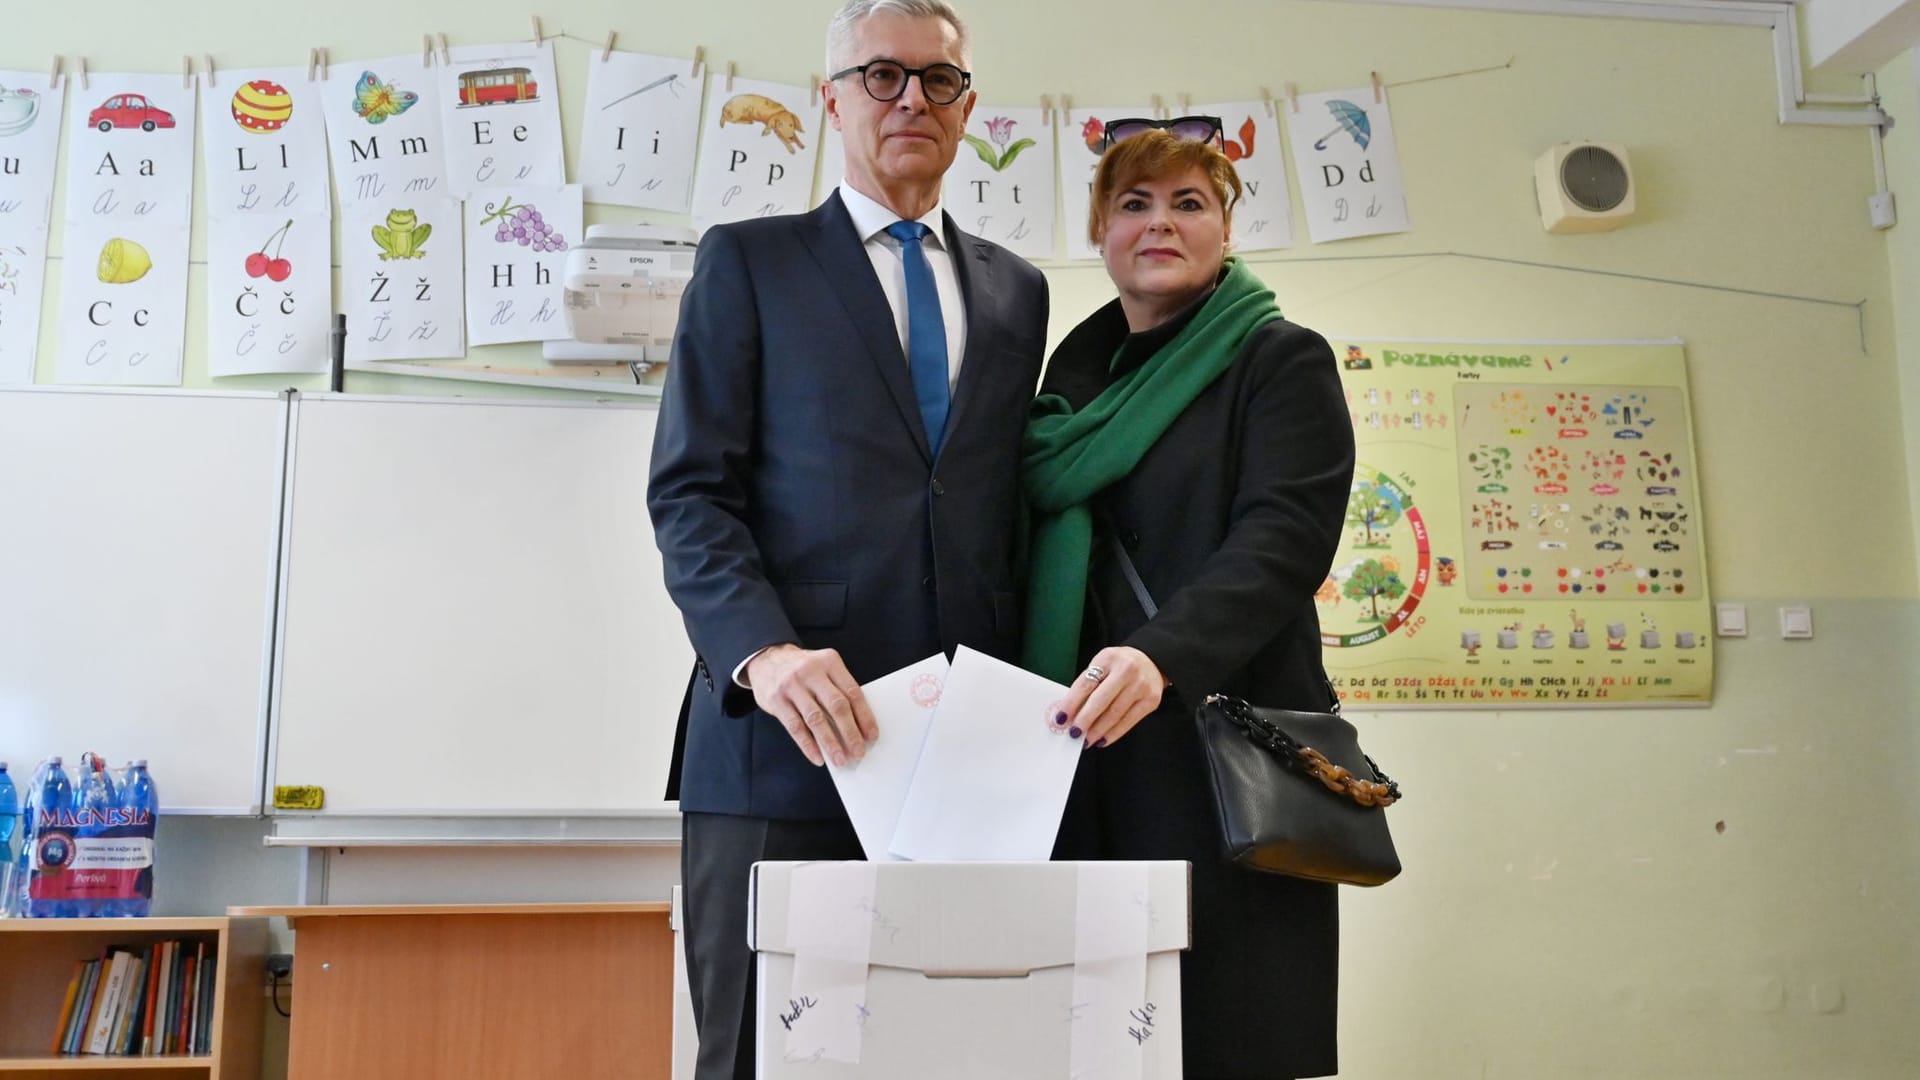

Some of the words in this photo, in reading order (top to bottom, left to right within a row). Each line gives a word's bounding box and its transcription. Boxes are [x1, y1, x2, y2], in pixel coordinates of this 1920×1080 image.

[472, 121, 493, 145] E
[513, 124, 528, 142] e
[616, 127, 626, 150] I
[651, 130, 660, 154] i
[236, 147, 257, 171] L
[280, 144, 289, 168] l
[350, 136, 381, 163] M
[399, 136, 428, 155] m
[3, 156, 21, 175] u
[94, 151, 120, 176] A
[139, 158, 155, 176] a
[476, 157, 496, 182] E
[514, 164, 533, 180] e
[728, 150, 748, 172] P
[767, 163, 784, 185] p
[1322, 164, 1344, 187] D
[1358, 160, 1375, 183] d
[237, 184, 260, 209] L
[275, 181, 298, 207] l
[355, 172, 385, 199] M
[403, 177, 437, 192] m
[722, 185, 742, 207] P
[971, 180, 990, 203] T
[1012, 184, 1022, 204] t
[1245, 182, 1259, 197] v
[92, 189, 120, 214] A
[133, 201, 157, 215] a
[1366, 195, 1383, 219] d
[370, 270, 391, 303] Ž
[415, 277, 432, 301] ž
[491, 263, 514, 288] H
[535, 261, 551, 285] h
[88, 300, 112, 327] C
[133, 308, 150, 327] c
[235, 286, 258, 317] Č
[279, 291, 295, 315] č
[530, 297, 556, 323] h
[85, 340, 107, 366] C
[129, 351, 150, 366] c
[1382, 349, 1532, 368] Poznávame
[1398, 471, 1417, 489] JAR
[1349, 629, 1380, 645] AUGUST
[1405, 615, 1427, 638] LETO
[1350, 678, 1365, 687] Dd
[1462, 677, 1476, 686] Ee
[1481, 677, 1493, 686] Ff
[1499, 677, 1514, 688] Gg
[1520, 676, 1534, 686] Hh
[1539, 676, 1567, 686] CHch
[1354, 690, 1371, 700] Qq
[1377, 690, 1389, 699] Rr
[1434, 689, 1446, 699] Tt
[1470, 689, 1484, 699] Uu
[1490, 689, 1504, 698] Vv
[1510, 689, 1528, 698] Ww
[1556, 689, 1570, 699] Yy
[39, 807, 149, 827] MAGNESIA
[47, 846, 63, 858] Mg
